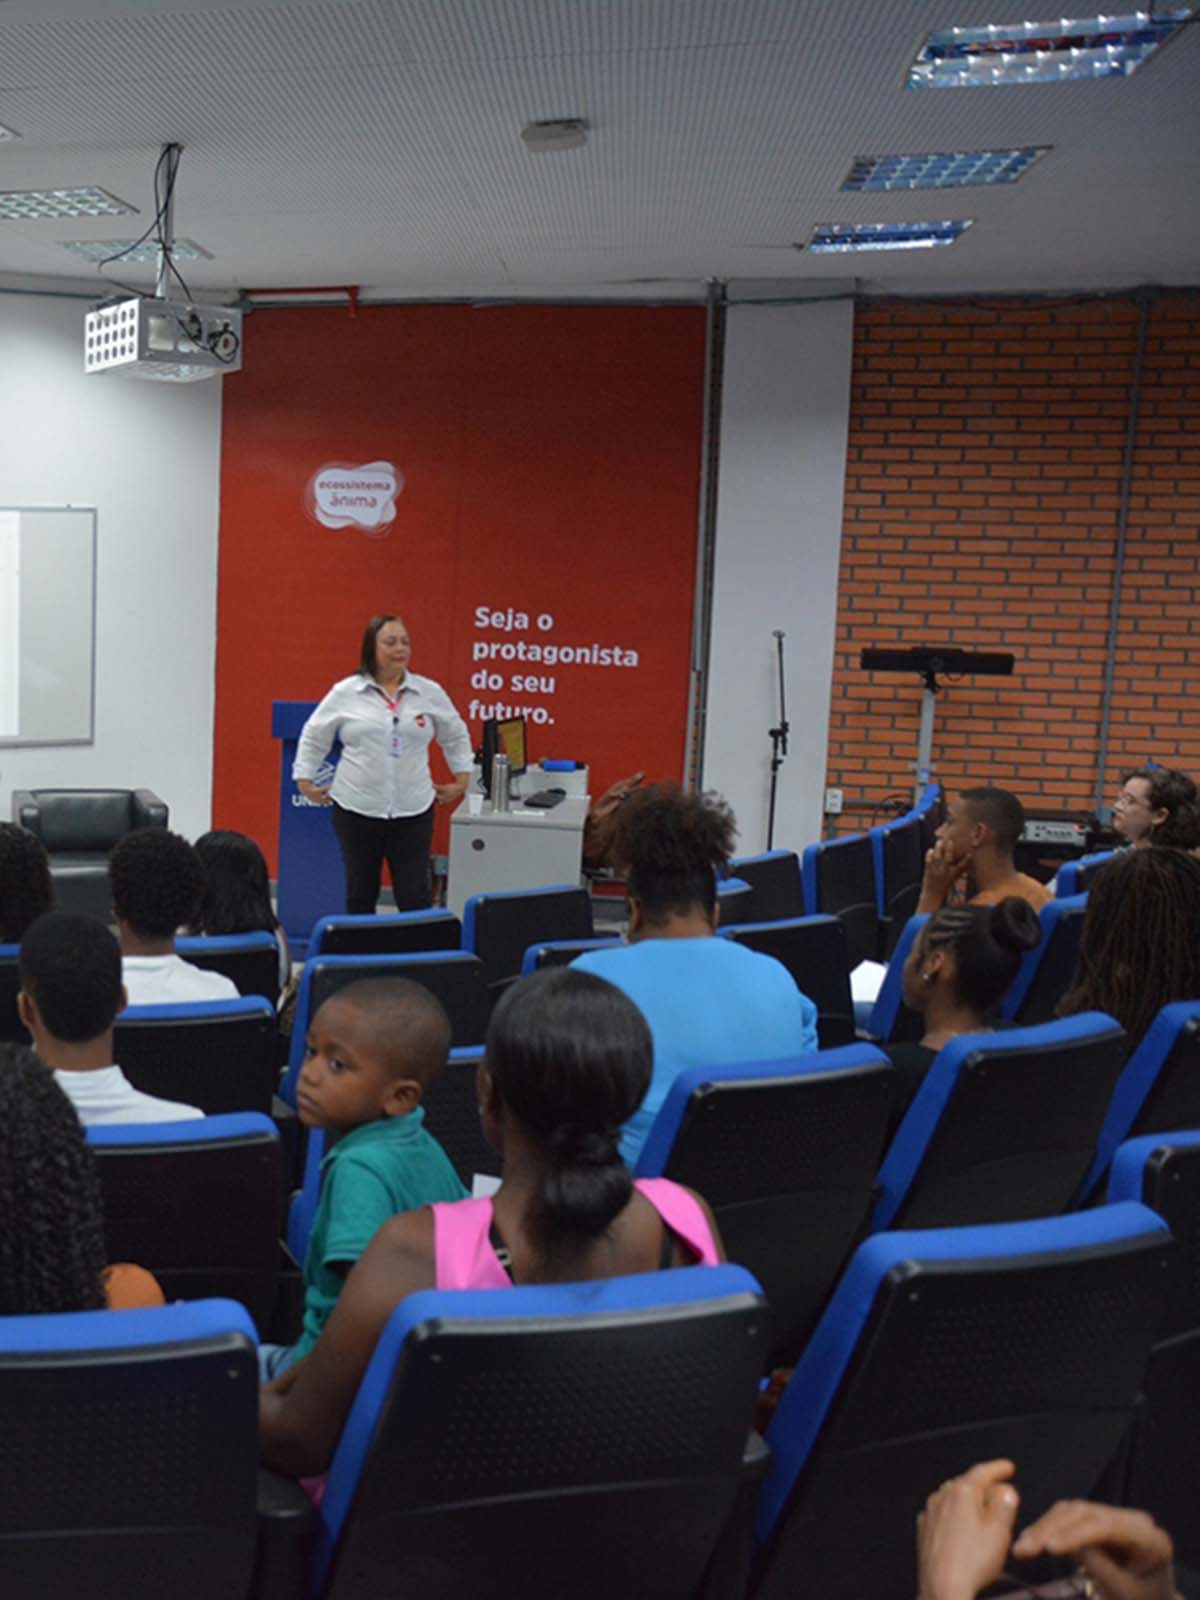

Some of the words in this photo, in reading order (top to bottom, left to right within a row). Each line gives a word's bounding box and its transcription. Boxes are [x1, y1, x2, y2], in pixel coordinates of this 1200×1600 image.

[319, 481, 391, 491] ecossistema
[474, 606, 529, 632] Seja
[536, 613, 554, 631] o
[472, 640, 639, 667] protagonista
[470, 669, 504, 690] do
[510, 674, 556, 694] seu
[468, 699, 555, 725] futuro.
